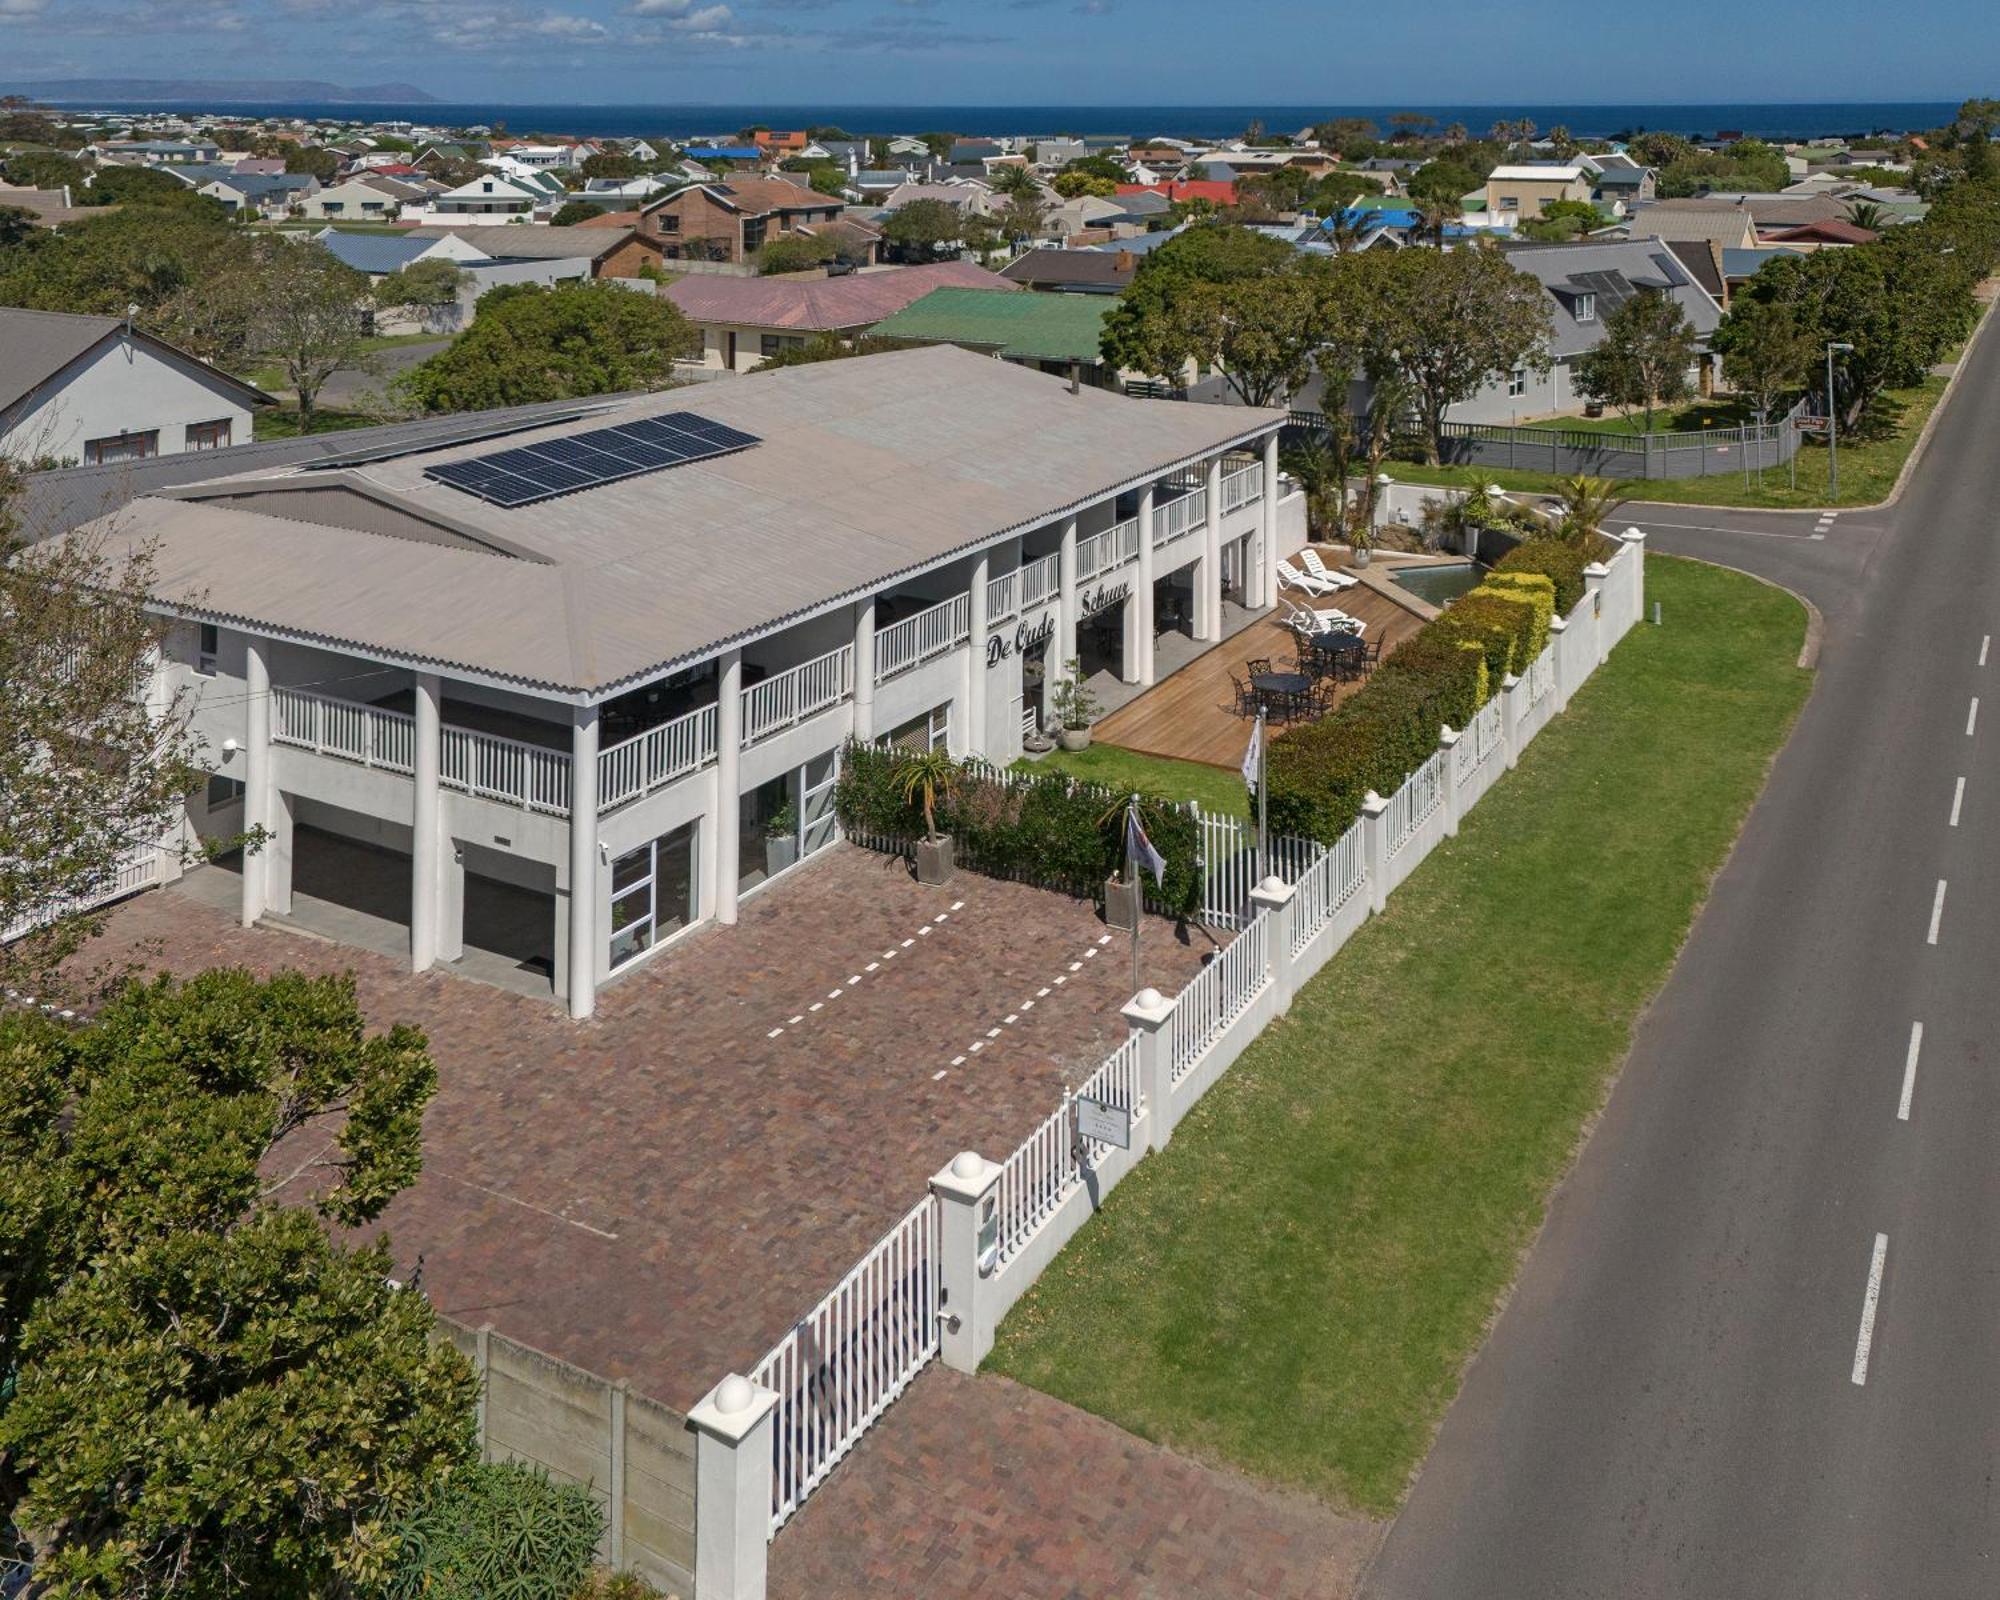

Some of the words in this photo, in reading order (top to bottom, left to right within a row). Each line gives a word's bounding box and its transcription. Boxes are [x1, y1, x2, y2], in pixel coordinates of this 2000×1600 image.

[987, 635, 1011, 668] De
[1016, 611, 1055, 654] Oude
[1082, 581, 1129, 617] Schuur
